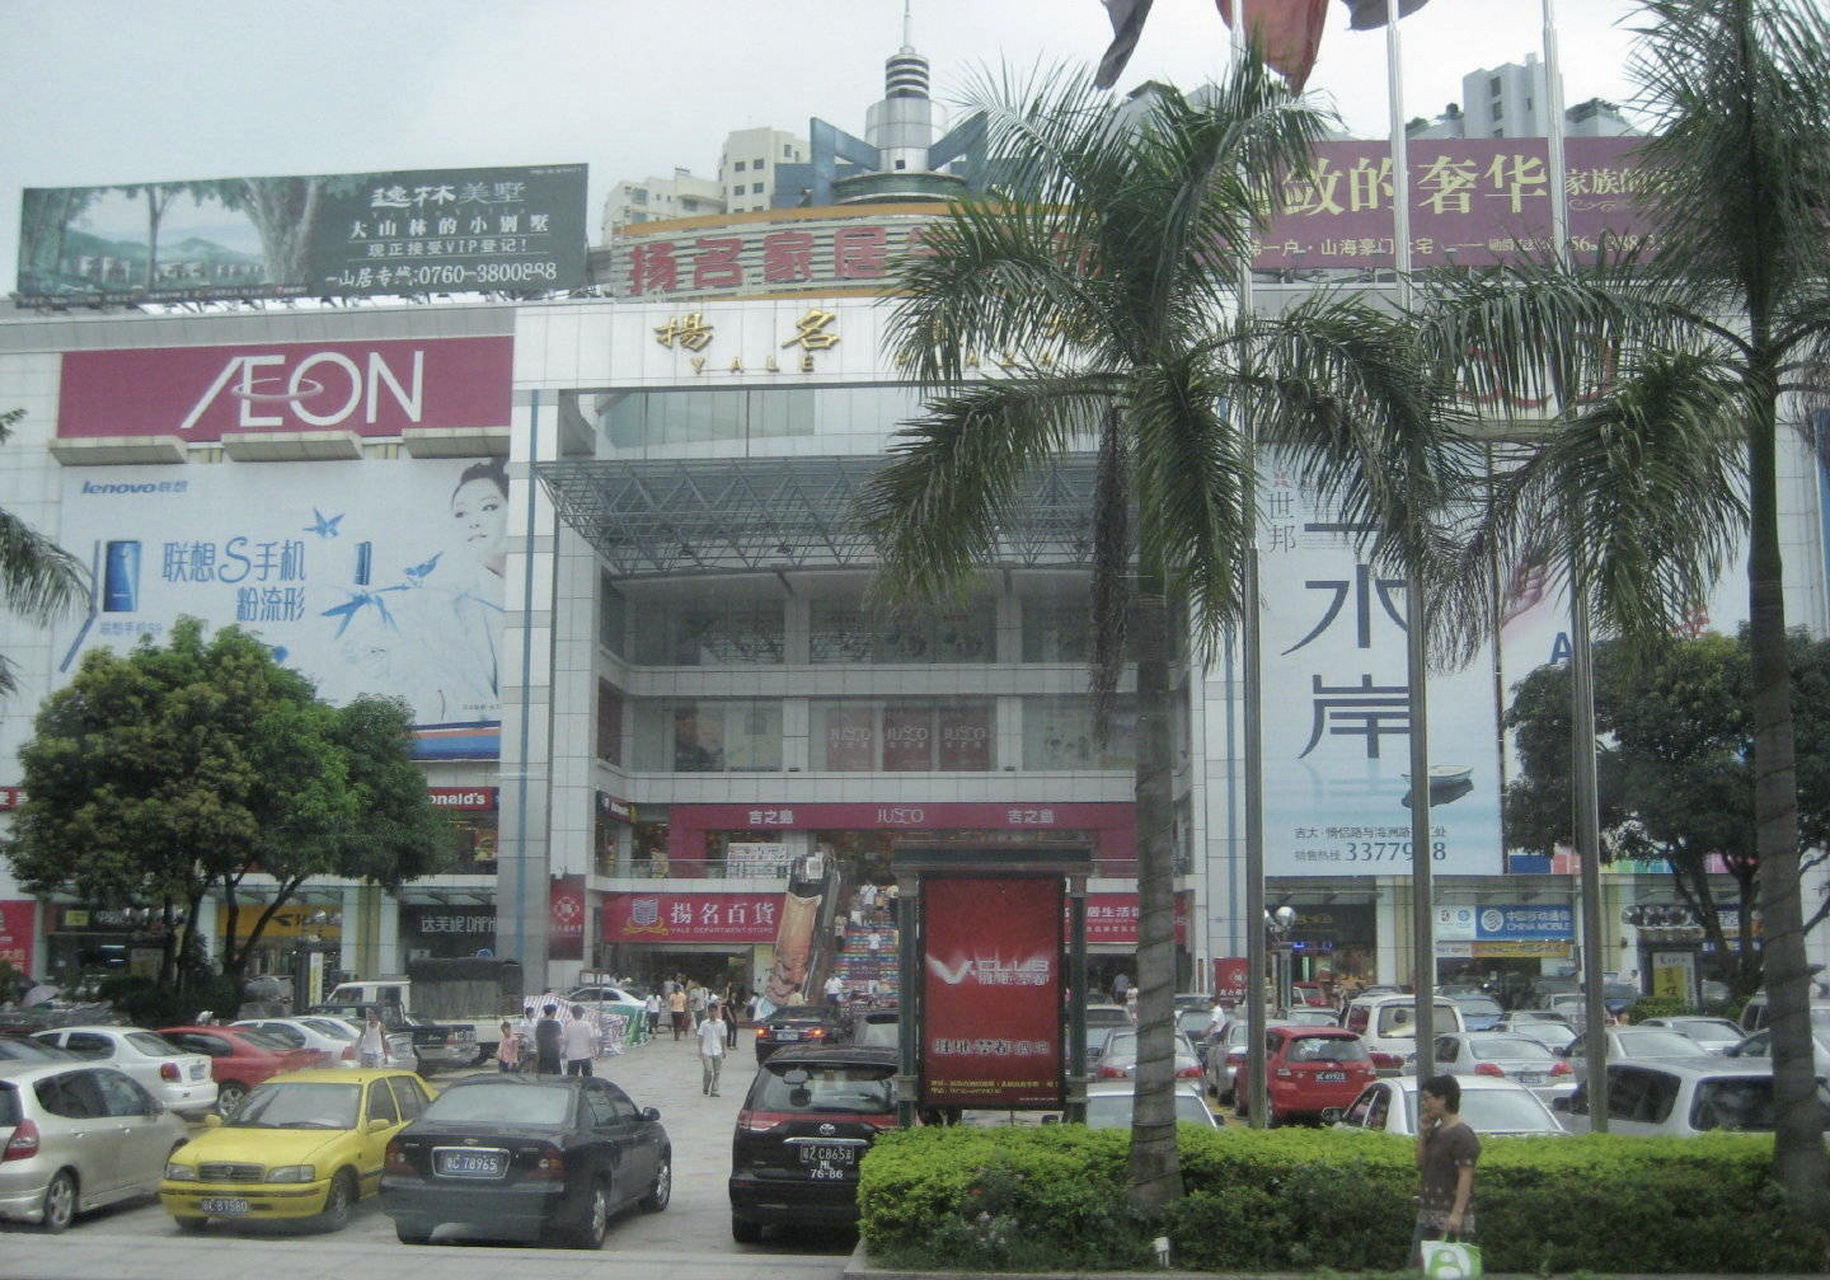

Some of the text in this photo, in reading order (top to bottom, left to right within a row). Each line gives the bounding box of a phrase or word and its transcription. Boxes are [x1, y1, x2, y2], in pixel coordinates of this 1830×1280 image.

[1250, 154, 1548, 217] 敛的奢华
[81, 480, 157, 495] lenovo
[1268, 491, 1296, 554] 世邦
[1278, 522, 1412, 760] 水岸
[876, 807, 925, 825] JUSCO
[1345, 842, 1447, 862] 337798
